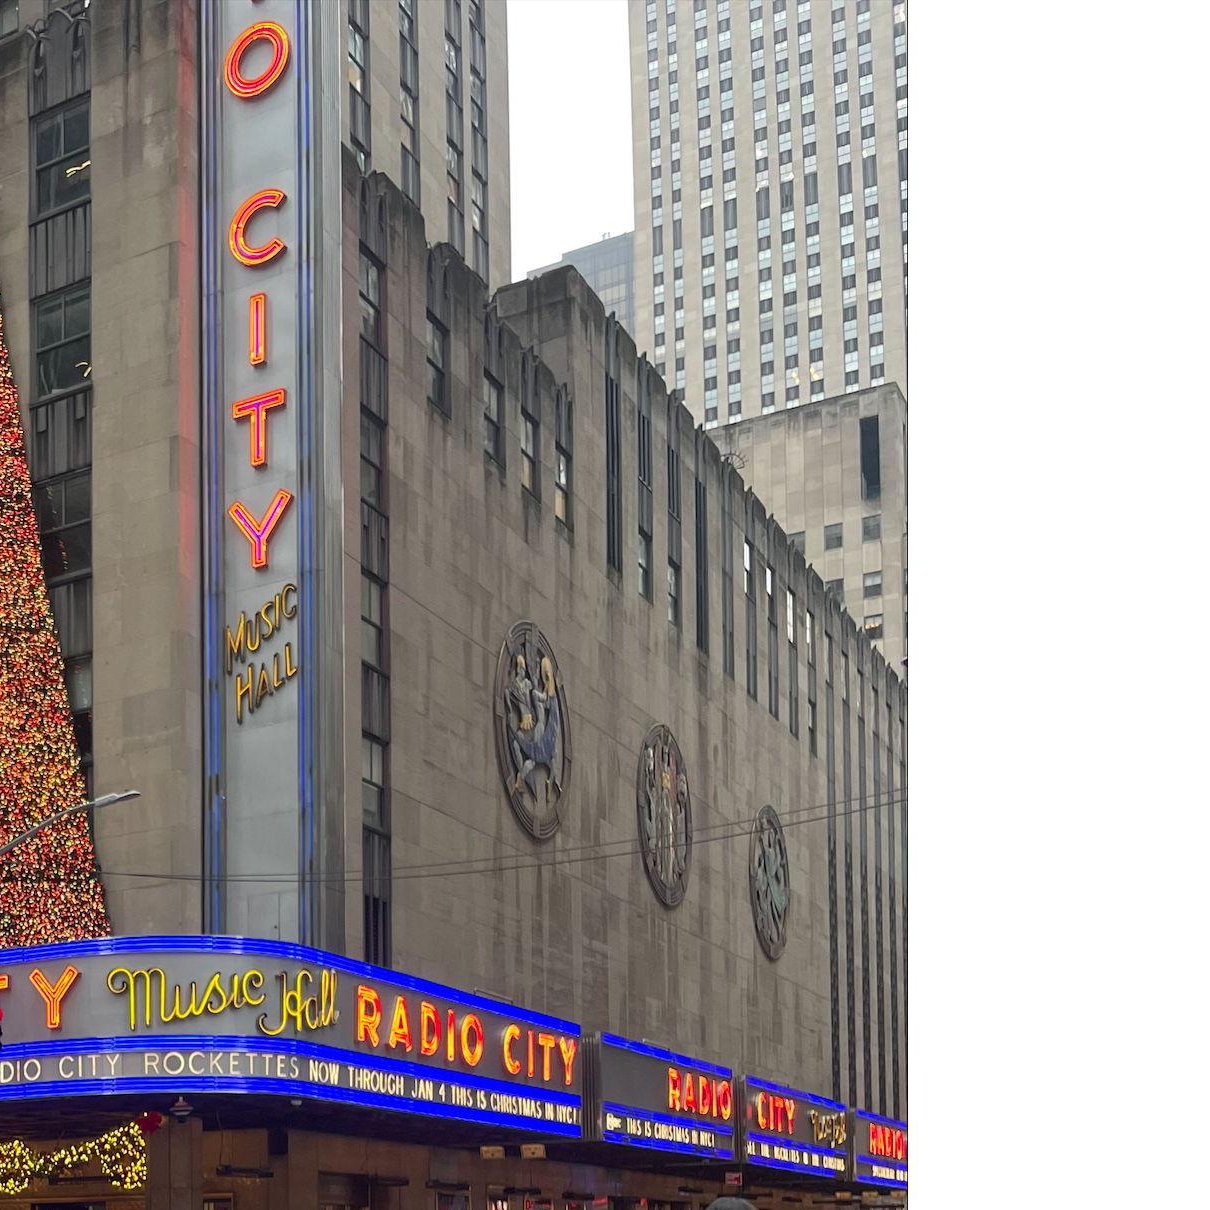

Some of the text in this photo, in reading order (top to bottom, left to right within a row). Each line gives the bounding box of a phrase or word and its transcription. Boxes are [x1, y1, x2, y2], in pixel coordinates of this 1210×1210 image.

[228, 188, 293, 569] CITY
[223, 583, 298, 675] MUSIC
[235, 642, 299, 724] HALL
[107, 967, 266, 1031] Music
[257, 968, 339, 1036] Hall
[356, 984, 485, 1067] RADIO
[502, 1023, 577, 1086] CITY
[58, 1054, 120, 1079] CITY
[143, 1051, 300, 1079] ROCKETTES
[308, 1058, 340, 1086] NOW
[347, 1065, 405, 1097] THROUGH
[411, 1078, 434, 1101] JAN
[438, 1085, 446, 1103] 4
[450, 1084, 473, 1107] THIS
[476, 1089, 487, 1110] IS
[489, 1093, 543, 1119] CHRISTMAS
[544, 1102, 555, 1121] IN
[667, 1066, 732, 1121] RADIO
[756, 1091, 796, 1135] CITY
[626, 1117, 642, 1136] THIS
[644, 1121, 652, 1138] IS
[869, 1122, 904, 1161] RADIO
